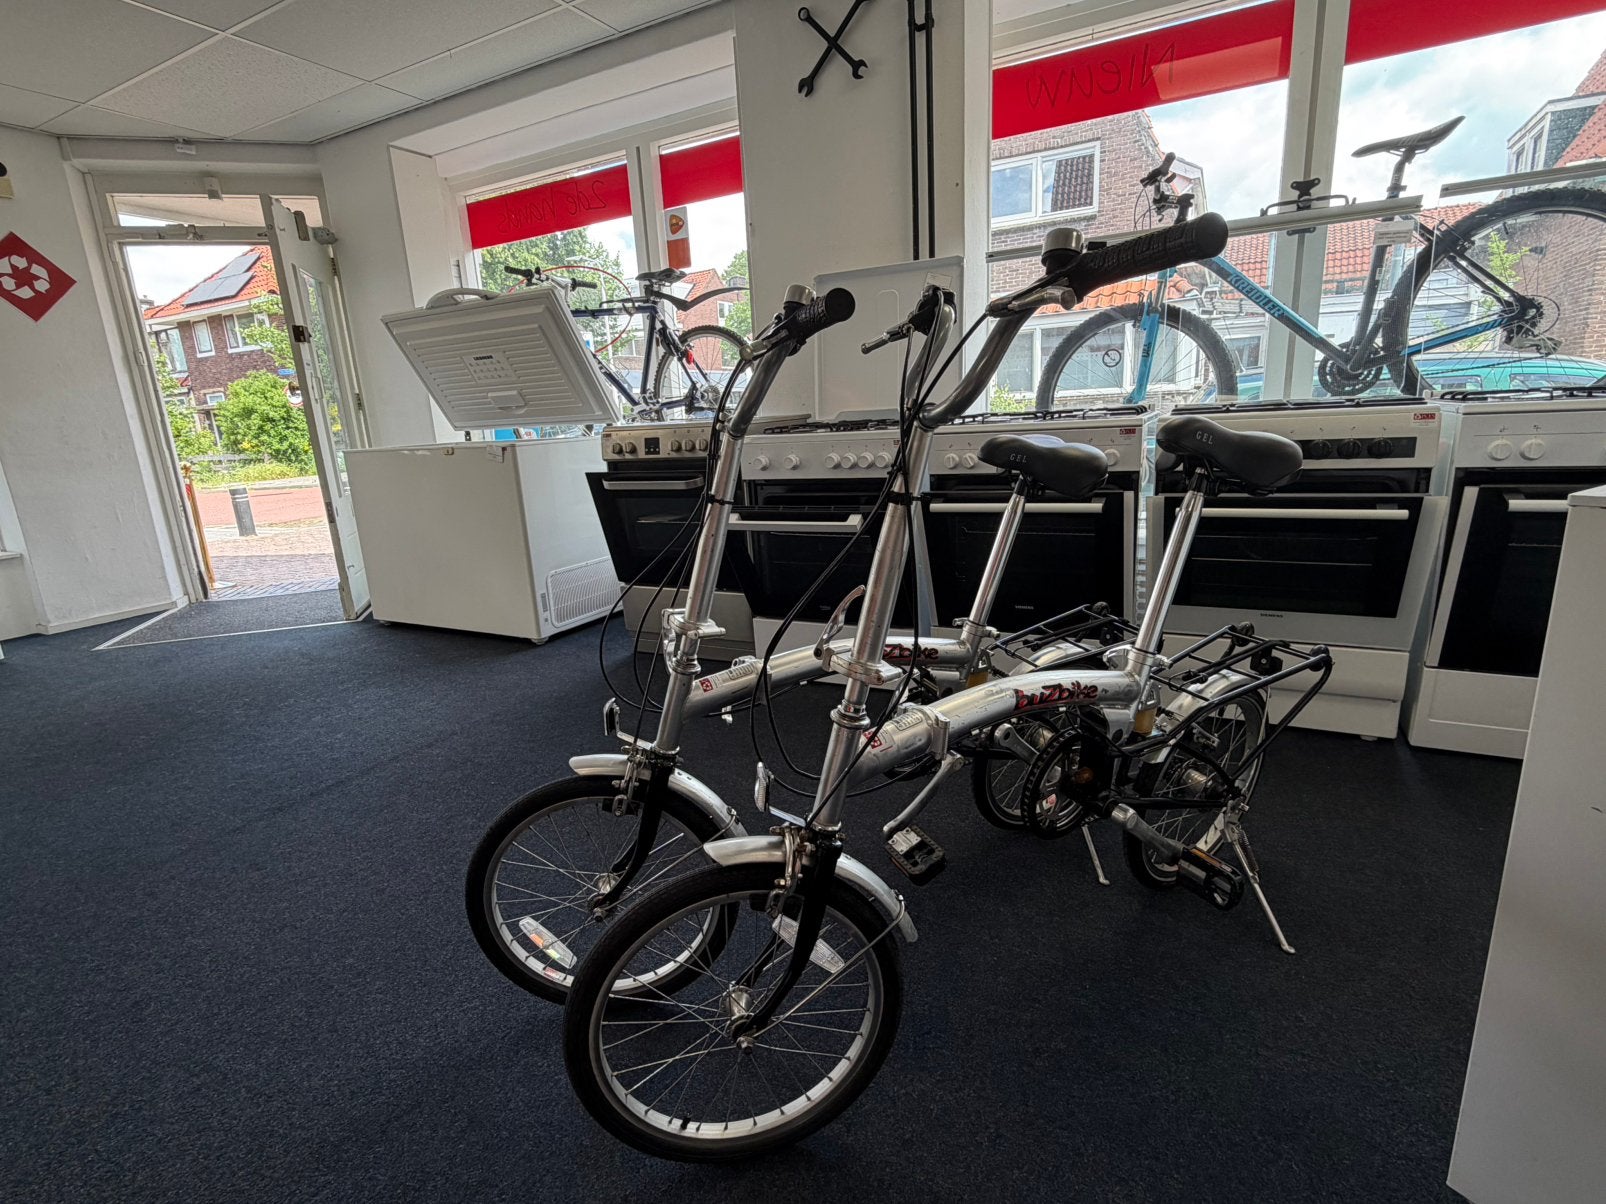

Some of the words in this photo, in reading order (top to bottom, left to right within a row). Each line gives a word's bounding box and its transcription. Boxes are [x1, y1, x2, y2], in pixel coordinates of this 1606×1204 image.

[1227, 272, 1286, 318] KREIDLER
[1195, 430, 1214, 445] GEL
[1009, 453, 1027, 463] GEL
